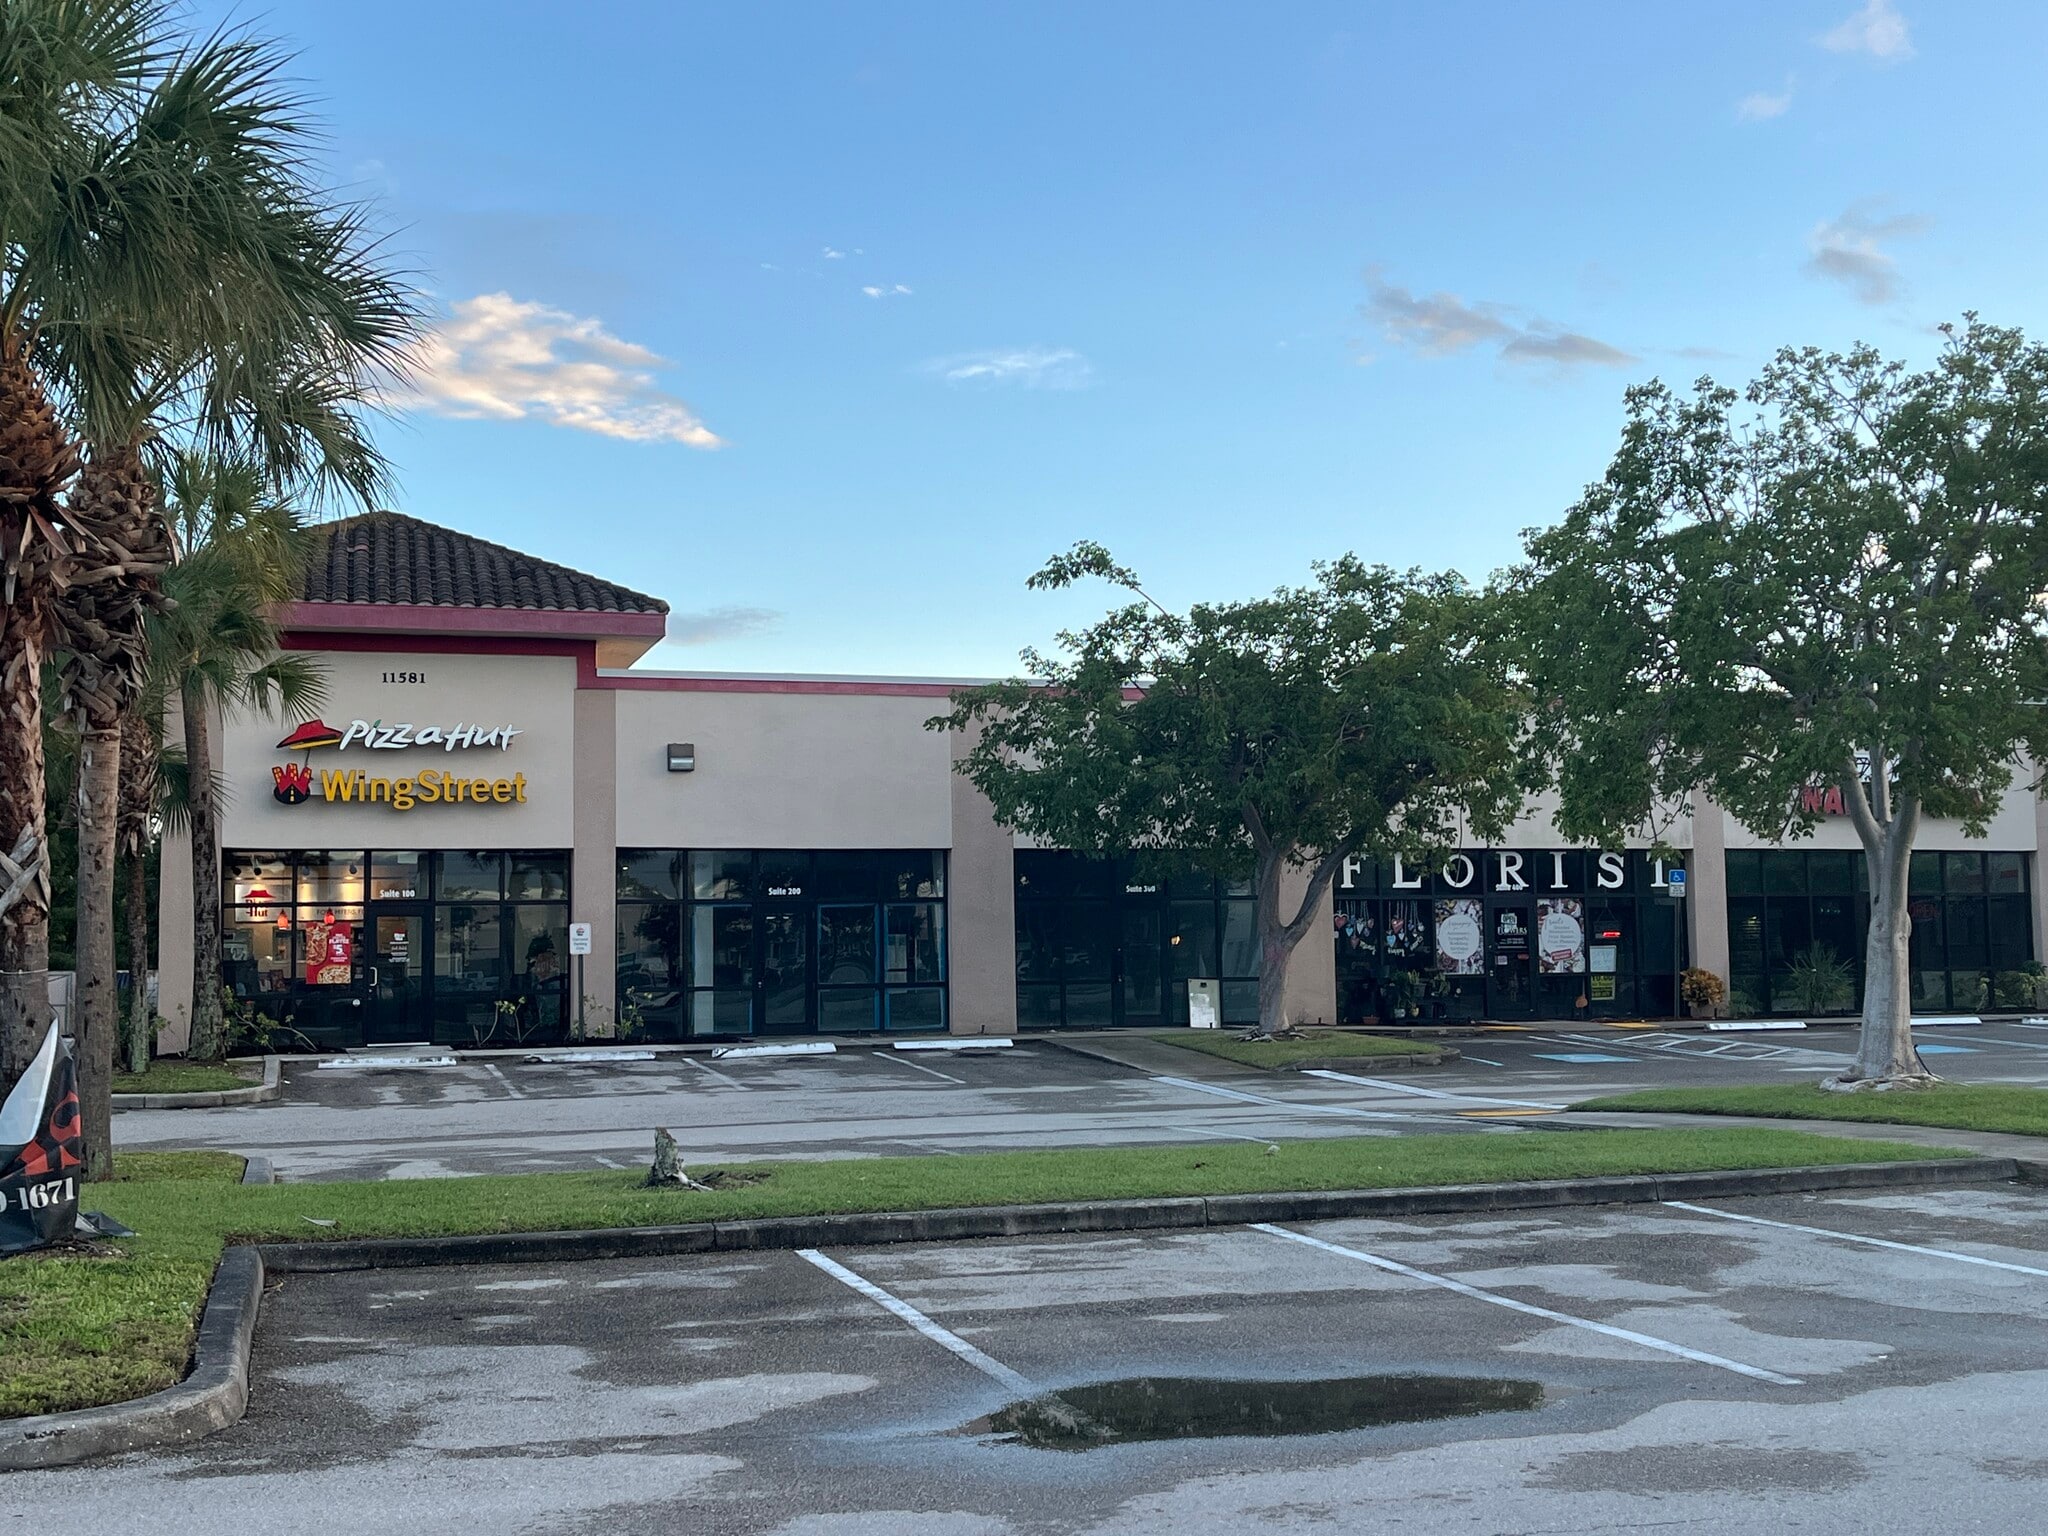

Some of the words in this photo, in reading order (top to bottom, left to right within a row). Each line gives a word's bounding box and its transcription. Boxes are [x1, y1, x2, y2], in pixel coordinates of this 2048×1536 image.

[382, 672, 426, 684] 11581
[339, 719, 442, 750] Pizza
[442, 721, 524, 751] Hut
[320, 769, 528, 810] WingStreet
[1340, 851, 1668, 888] FLORIST
[380, 889, 400, 897] Suite
[402, 889, 415, 897] 100
[768, 887, 786, 895] Suite
[788, 887, 801, 895] 200
